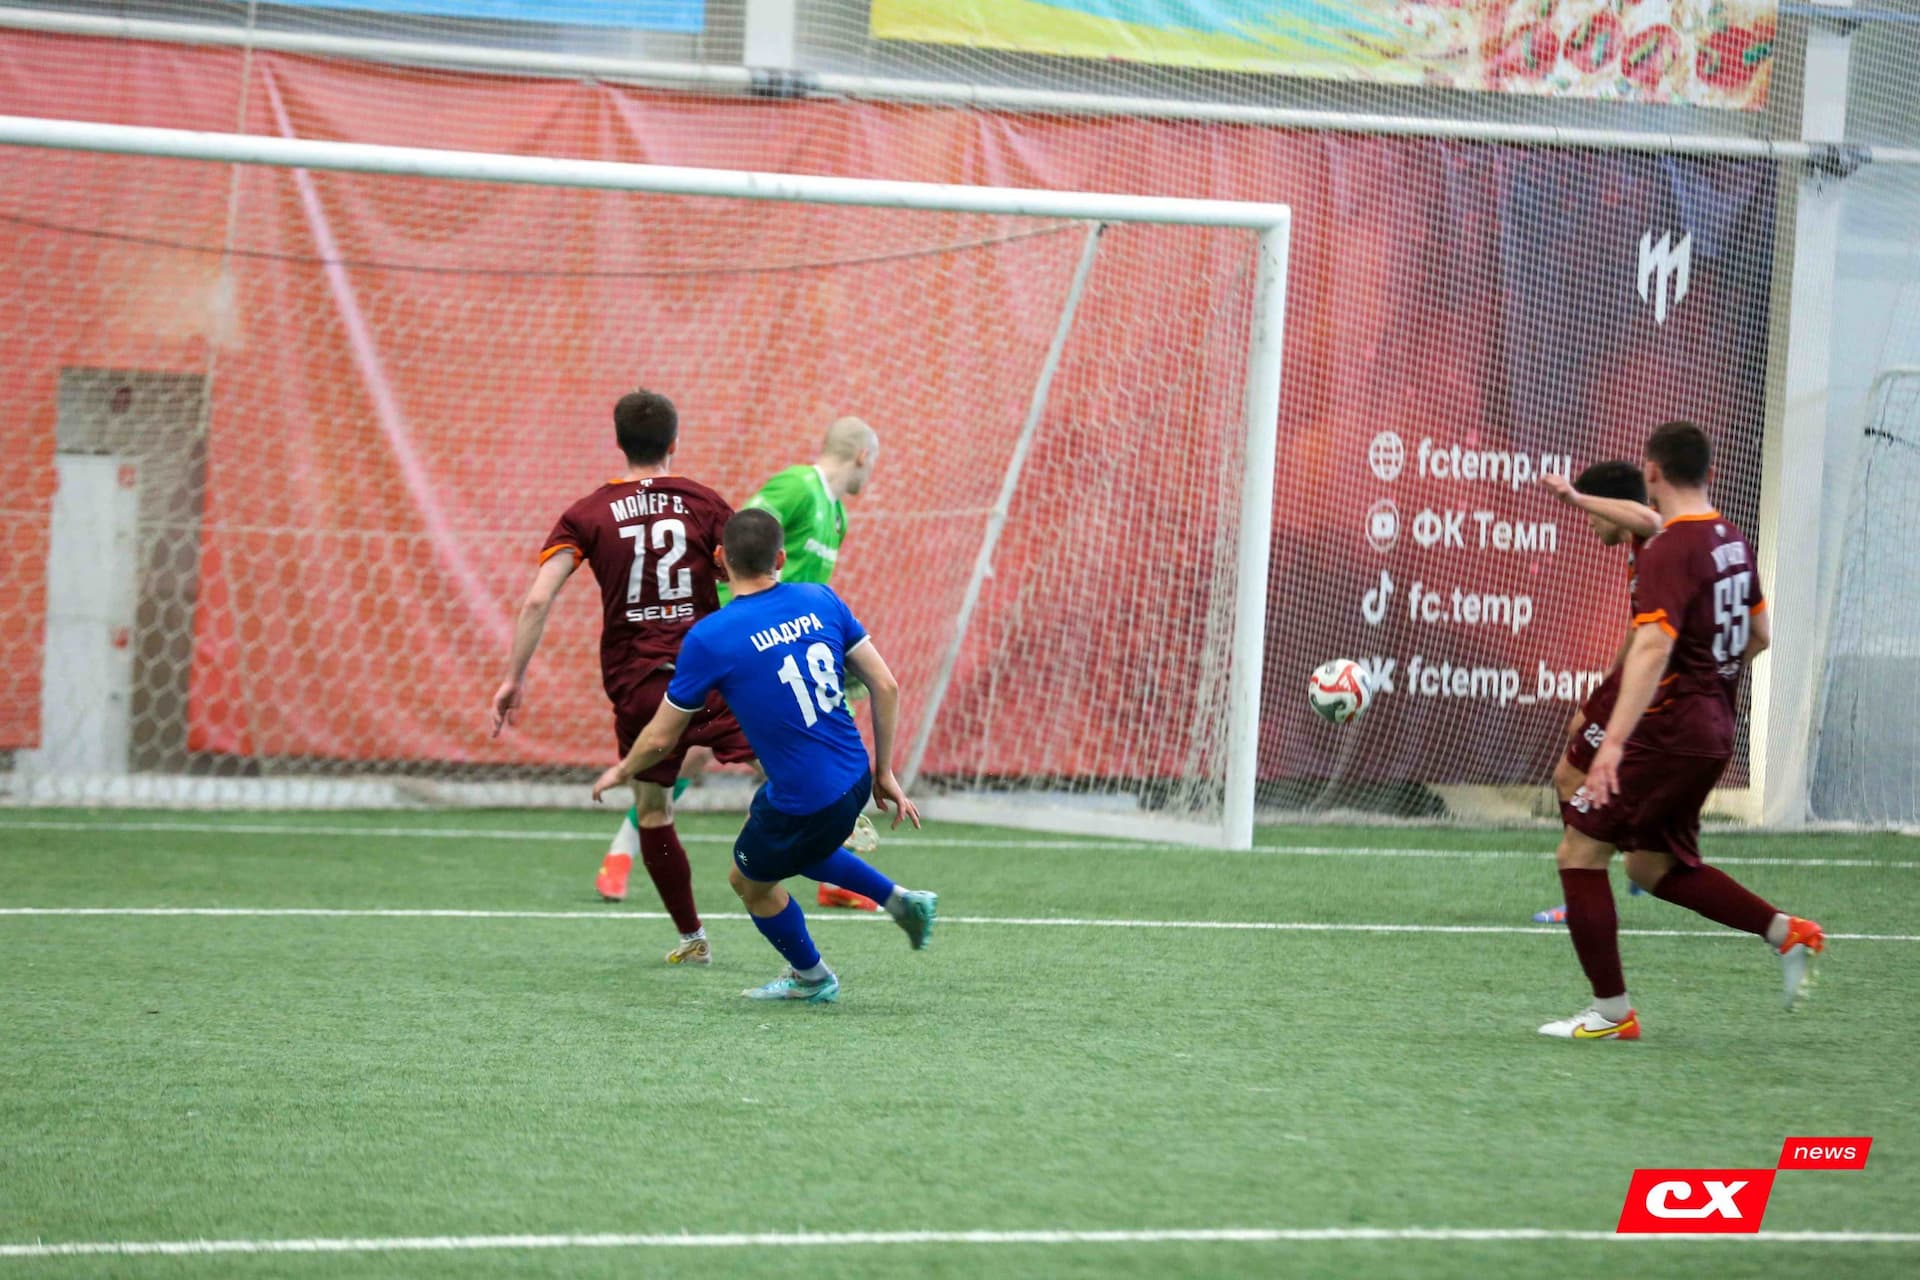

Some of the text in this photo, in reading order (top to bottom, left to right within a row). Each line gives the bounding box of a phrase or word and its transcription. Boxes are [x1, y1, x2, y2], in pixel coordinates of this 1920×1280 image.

[609, 489, 668, 522] МАЙЕР
[1412, 508, 1557, 553] ФК Темп
[618, 518, 693, 603] 72
[625, 603, 695, 622] SEUS
[750, 612, 823, 652] ШАДУРА
[1407, 581, 1533, 635] fc.temp
[1711, 571, 1751, 662] 55
[777, 642, 845, 728] 18
